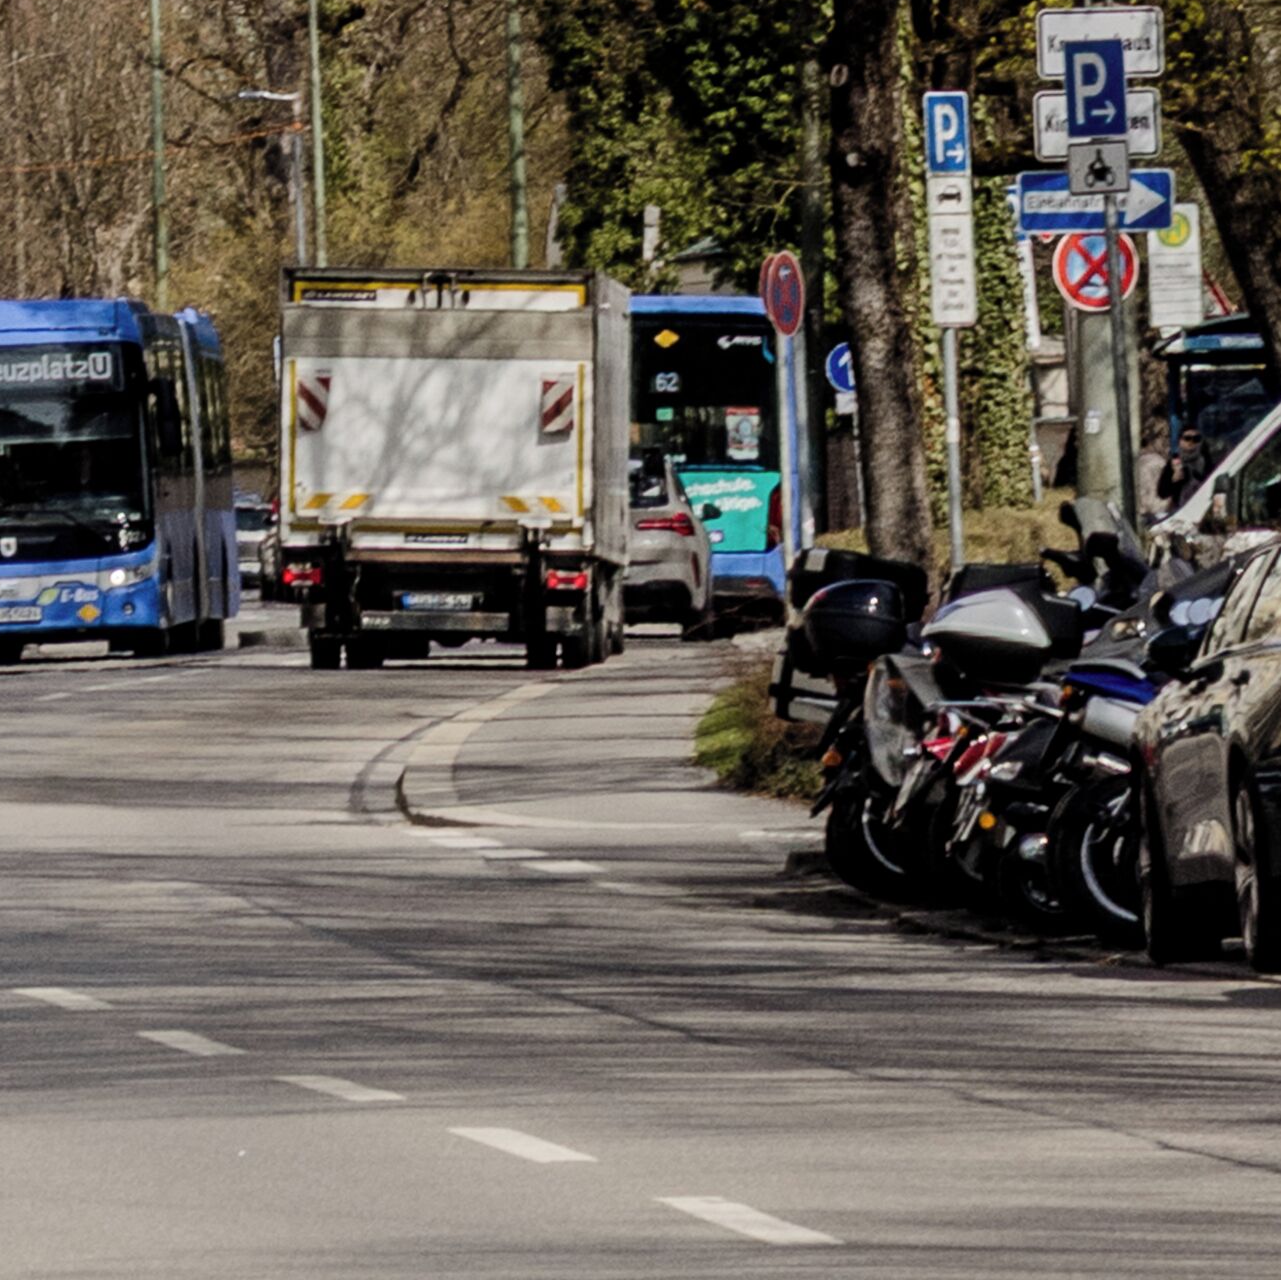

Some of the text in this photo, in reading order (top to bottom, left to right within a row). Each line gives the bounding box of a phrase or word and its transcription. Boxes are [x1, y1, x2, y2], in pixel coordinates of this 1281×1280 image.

[1073, 51, 1107, 126] P
[934, 103, 959, 164] P
[655, 371, 679, 392] 62
